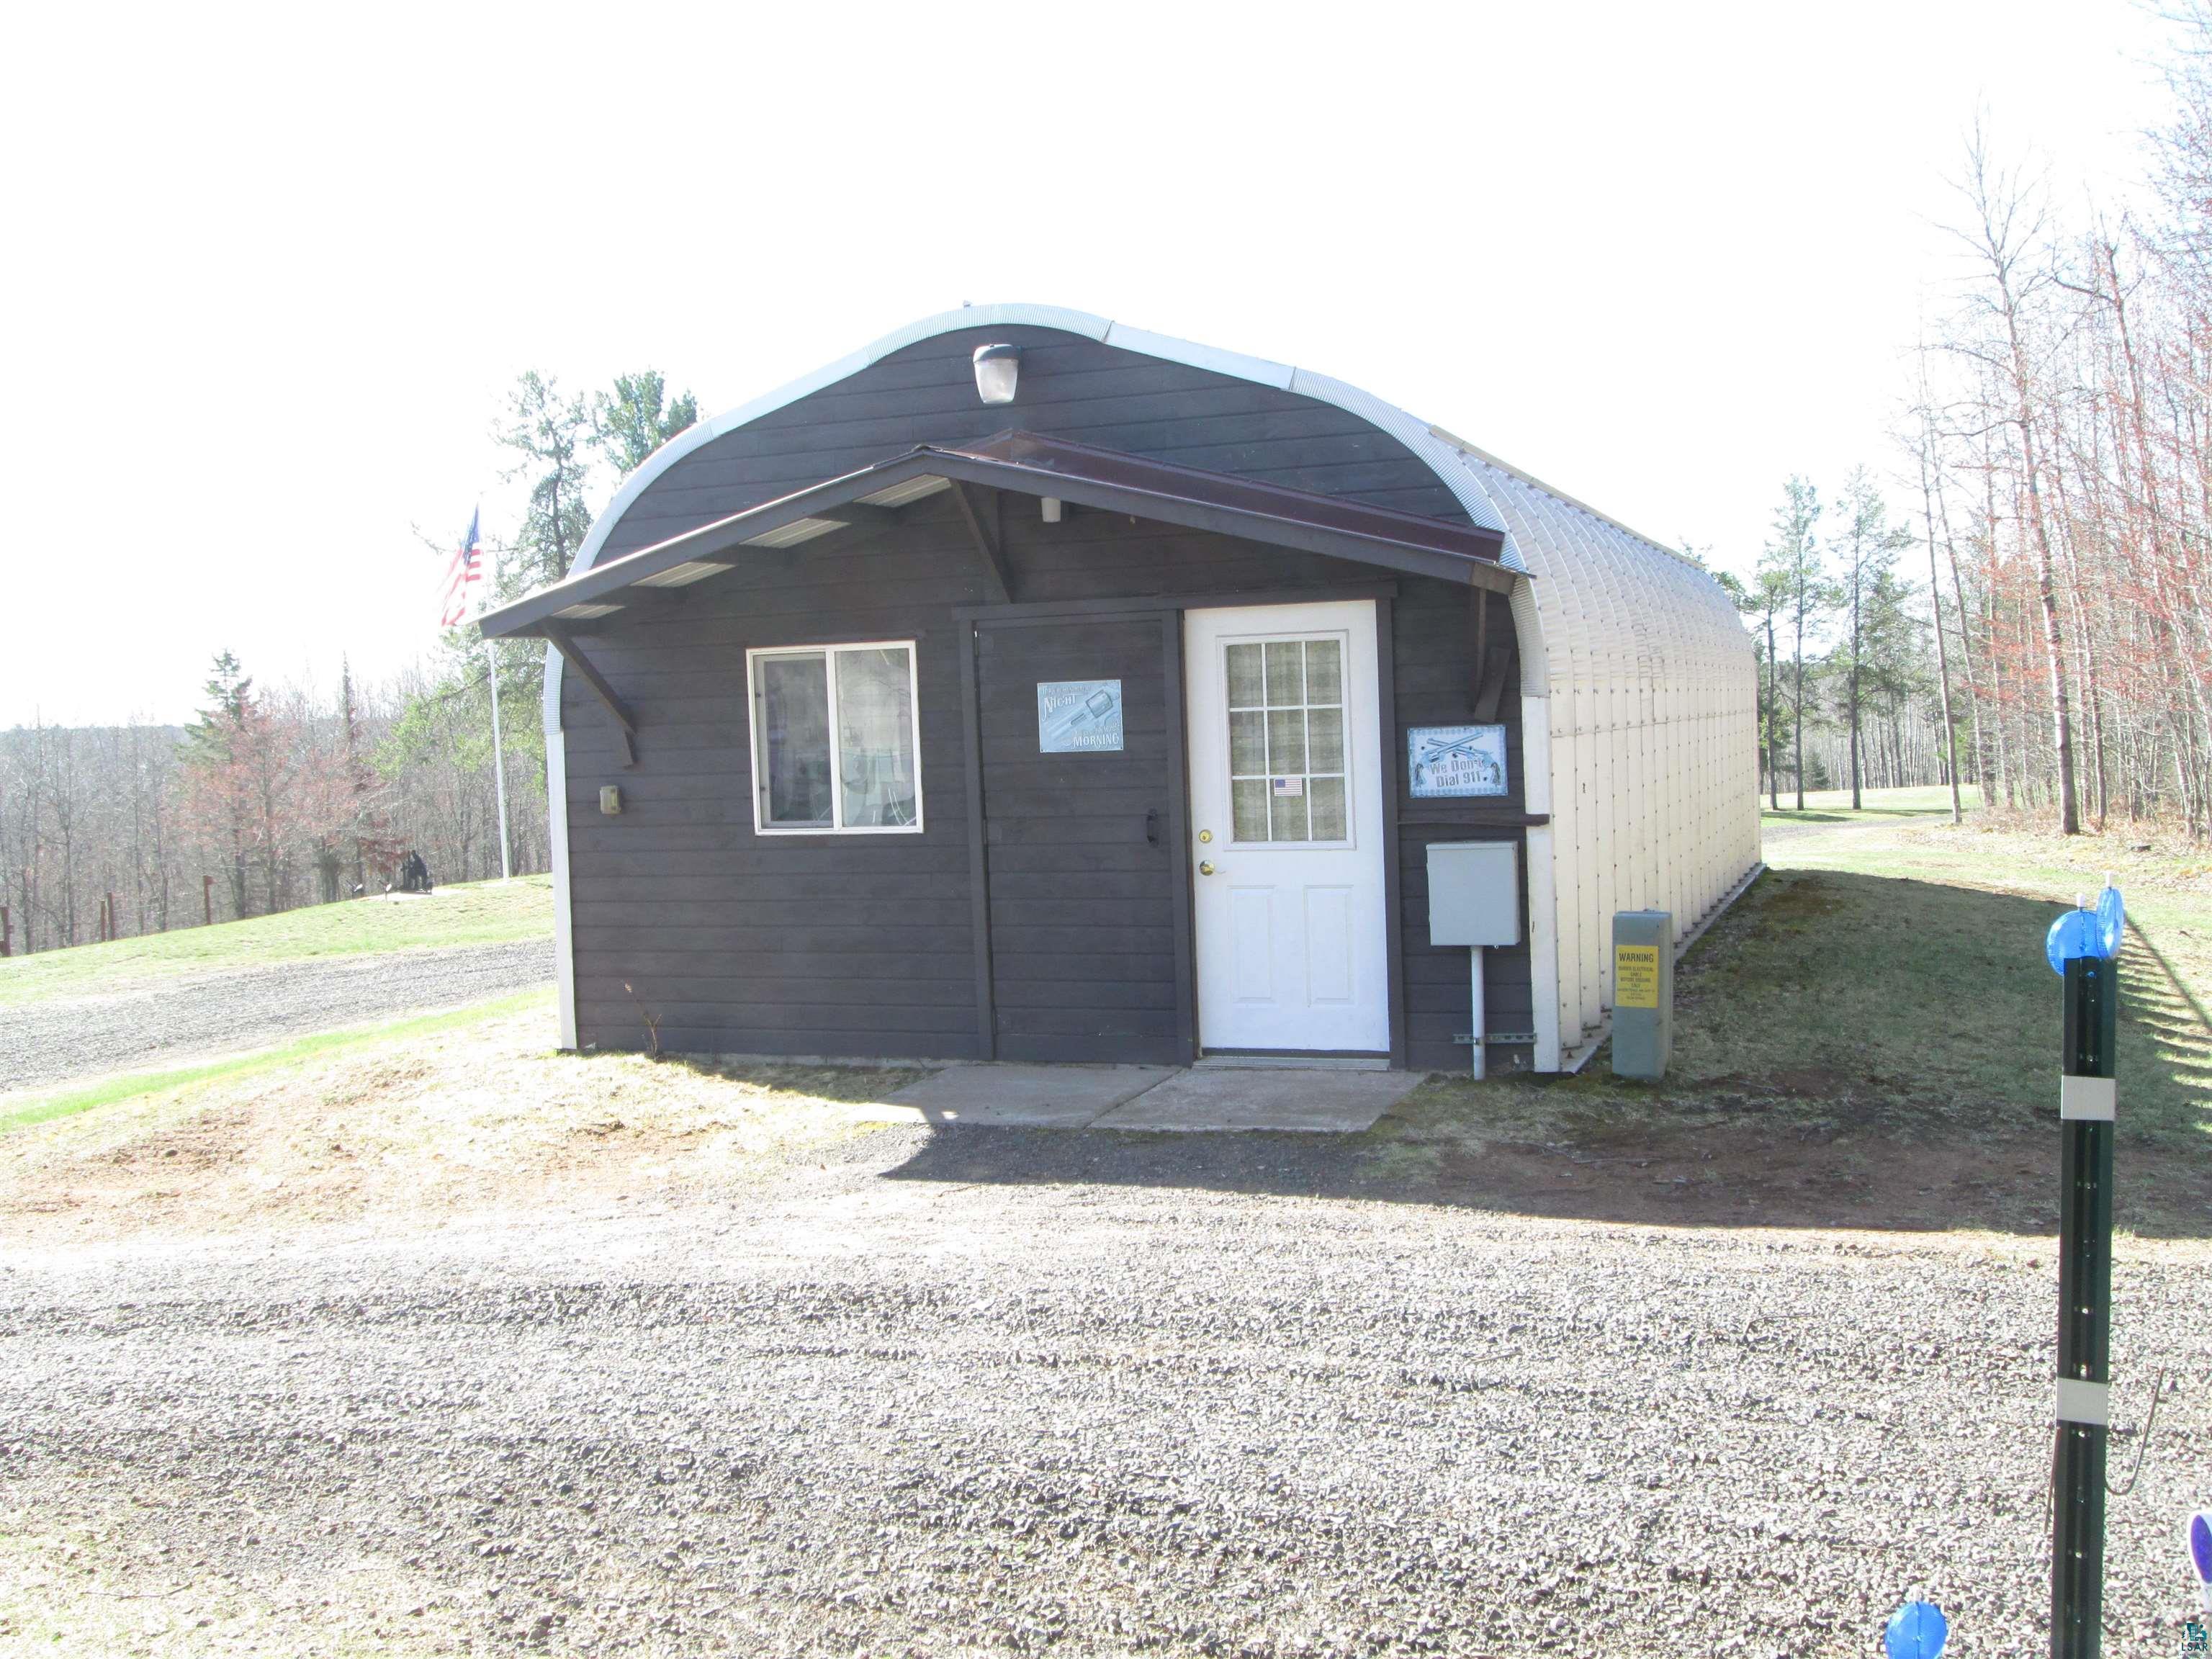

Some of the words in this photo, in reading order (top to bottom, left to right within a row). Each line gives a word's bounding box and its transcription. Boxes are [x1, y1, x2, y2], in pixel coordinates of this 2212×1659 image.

[1073, 733, 1119, 749] MORNING
[1429, 762, 1447, 775] We
[1436, 774, 1460, 788] Dial
[1463, 771, 1481, 784] 911
[1619, 953, 1654, 963] WARNING
